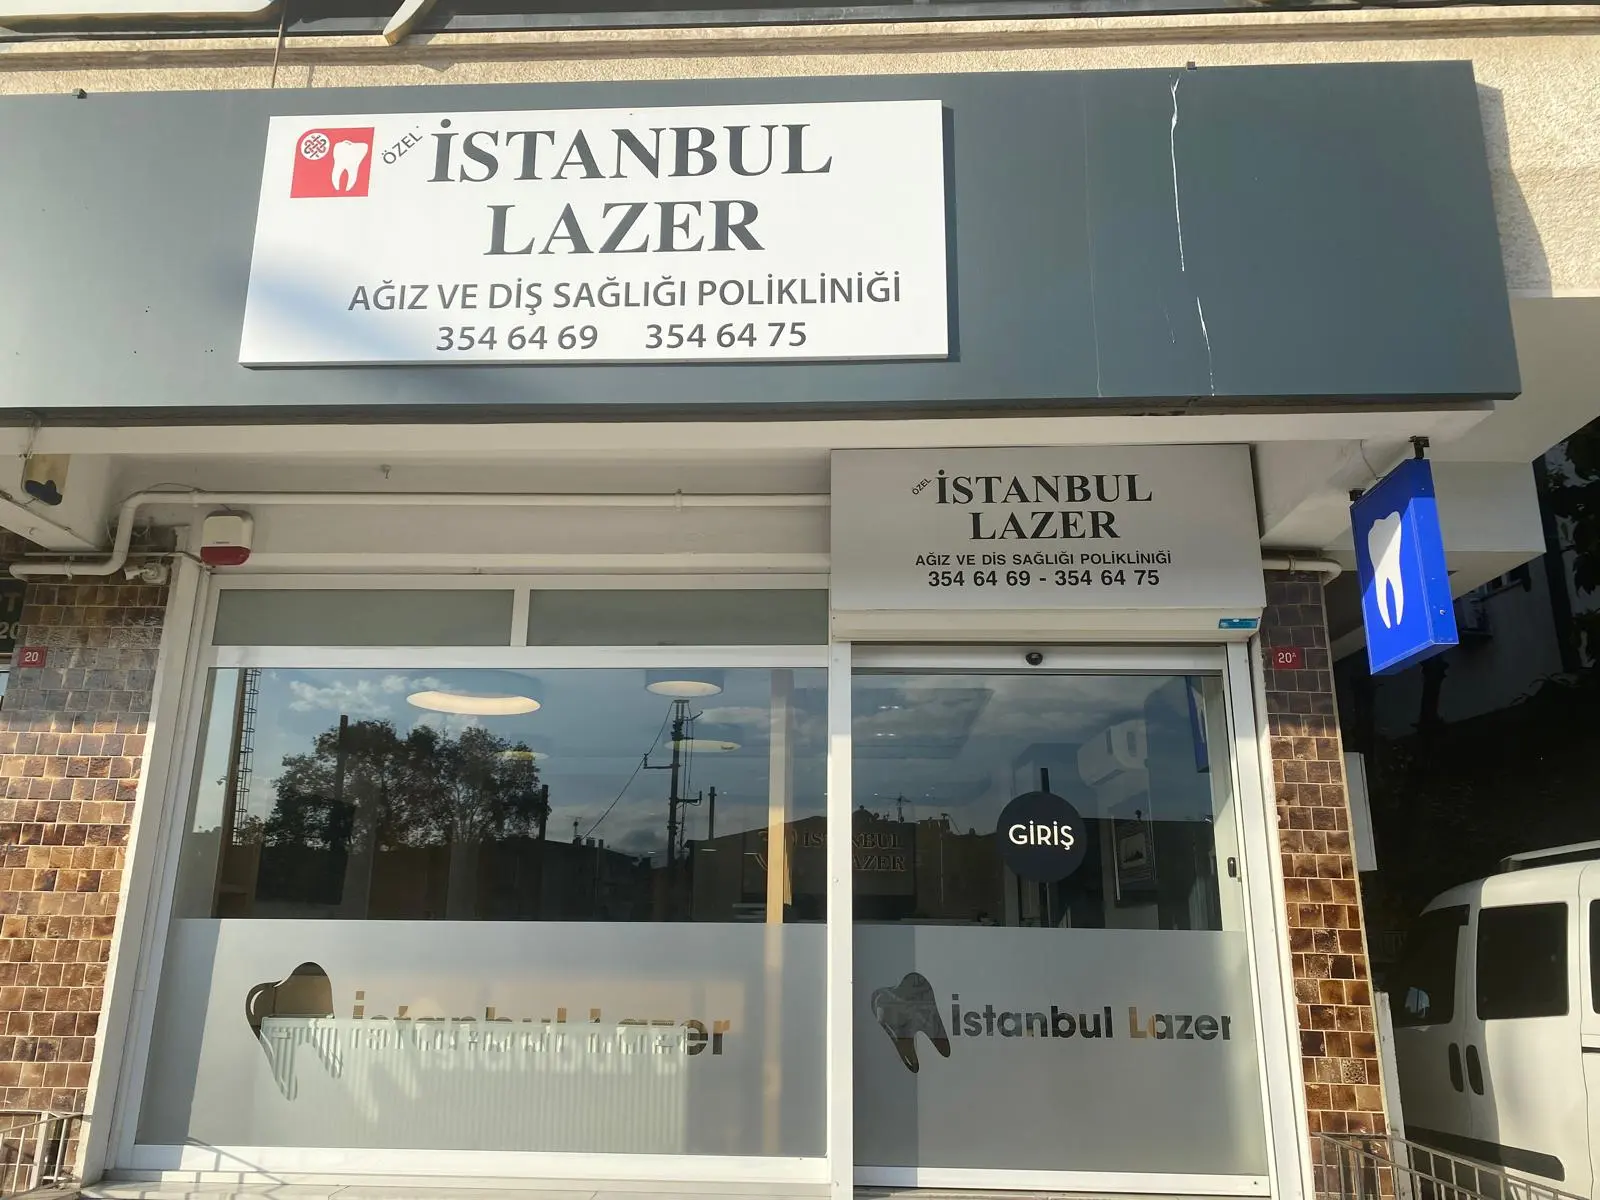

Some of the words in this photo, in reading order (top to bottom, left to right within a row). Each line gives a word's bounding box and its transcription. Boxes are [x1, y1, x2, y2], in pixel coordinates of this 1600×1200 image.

[381, 132, 423, 164] ÖZEL
[427, 118, 832, 183] İSTANBUL
[483, 200, 766, 256] LAZER
[348, 279, 429, 312] AĞIZ
[437, 283, 478, 310] VE
[489, 277, 543, 316] DİŞ
[553, 275, 685, 309] SAĞLIĞI
[699, 270, 901, 306] POLİKLİNİĞİ
[435, 326, 498, 351] 354
[507, 325, 548, 350] 64
[557, 324, 598, 350] 69
[644, 323, 707, 349] 354
[716, 322, 757, 348] 64
[767, 321, 807, 347] 75
[935, 469, 1152, 505] İSTANBUL
[968, 510, 1121, 540] LAZER
[915, 551, 951, 566] AĞIZ
[956, 554, 976, 566] VE
[1012, 550, 1074, 566] SAĞLIĞI
[928, 570, 965, 587] 354
[973, 570, 998, 587] 64
[1006, 569, 1031, 587] 69
[1054, 569, 1093, 586] 354
[1100, 569, 1126, 586] 64
[1133, 569, 1160, 586] 75
[24, 651, 39, 662] 20
[1008, 819, 1075, 851] GİRİŞ
[1129, 1006, 1232, 1041] Lazer
